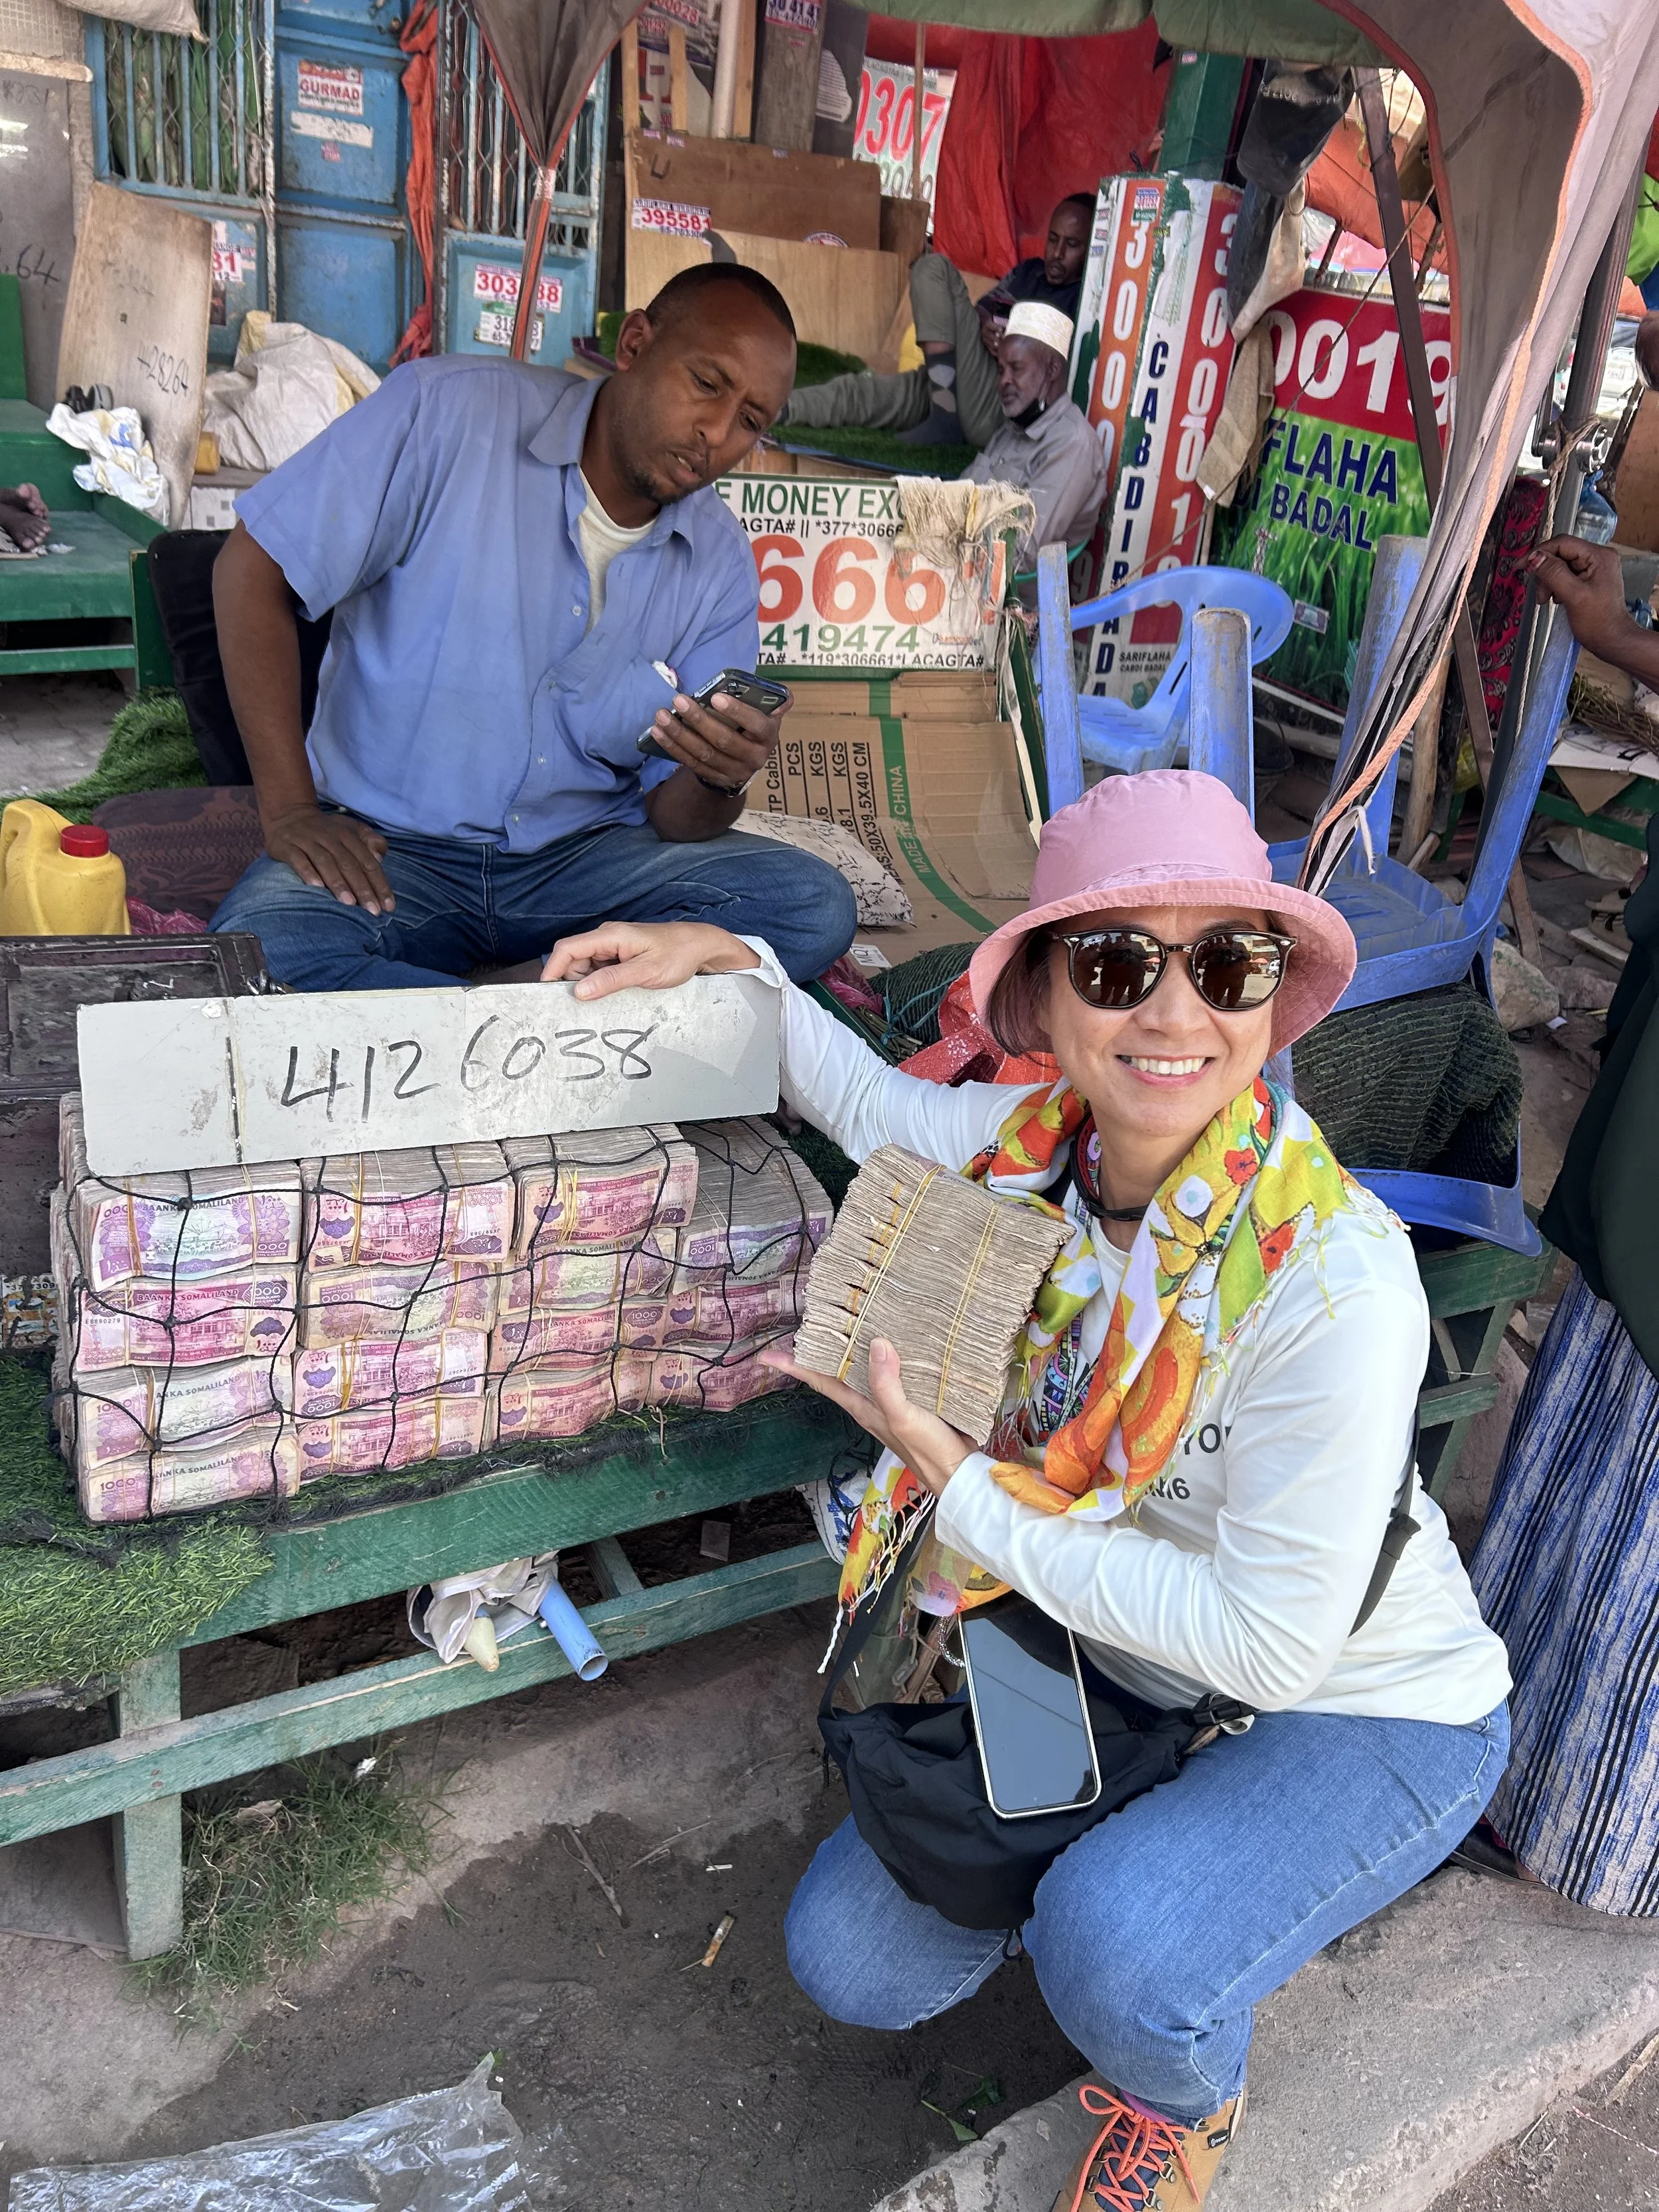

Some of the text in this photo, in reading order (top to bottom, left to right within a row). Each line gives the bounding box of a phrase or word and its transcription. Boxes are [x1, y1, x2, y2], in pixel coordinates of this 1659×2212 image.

[300, 78, 360, 100] GURMAD
[642, 208, 711, 230] 395581
[741, 482, 851, 517] MONEY
[1269, 482, 1374, 553] BADAL
[786, 742, 802, 776] PCS
[808, 741, 825, 777] KGS
[831, 742, 847, 778] KGS
[853, 742, 867, 767] CM
[889, 765, 906, 816] CHINA
[903, 840, 932, 874] MADE
[690, 1245, 715, 1256] 1000
[180, 1289, 239, 1301] SOMALILAND
[321, 1292, 354, 1302] 1000
[631, 1311, 658, 1320] 1000
[185, 1375, 240, 1394] SOMALILAND
